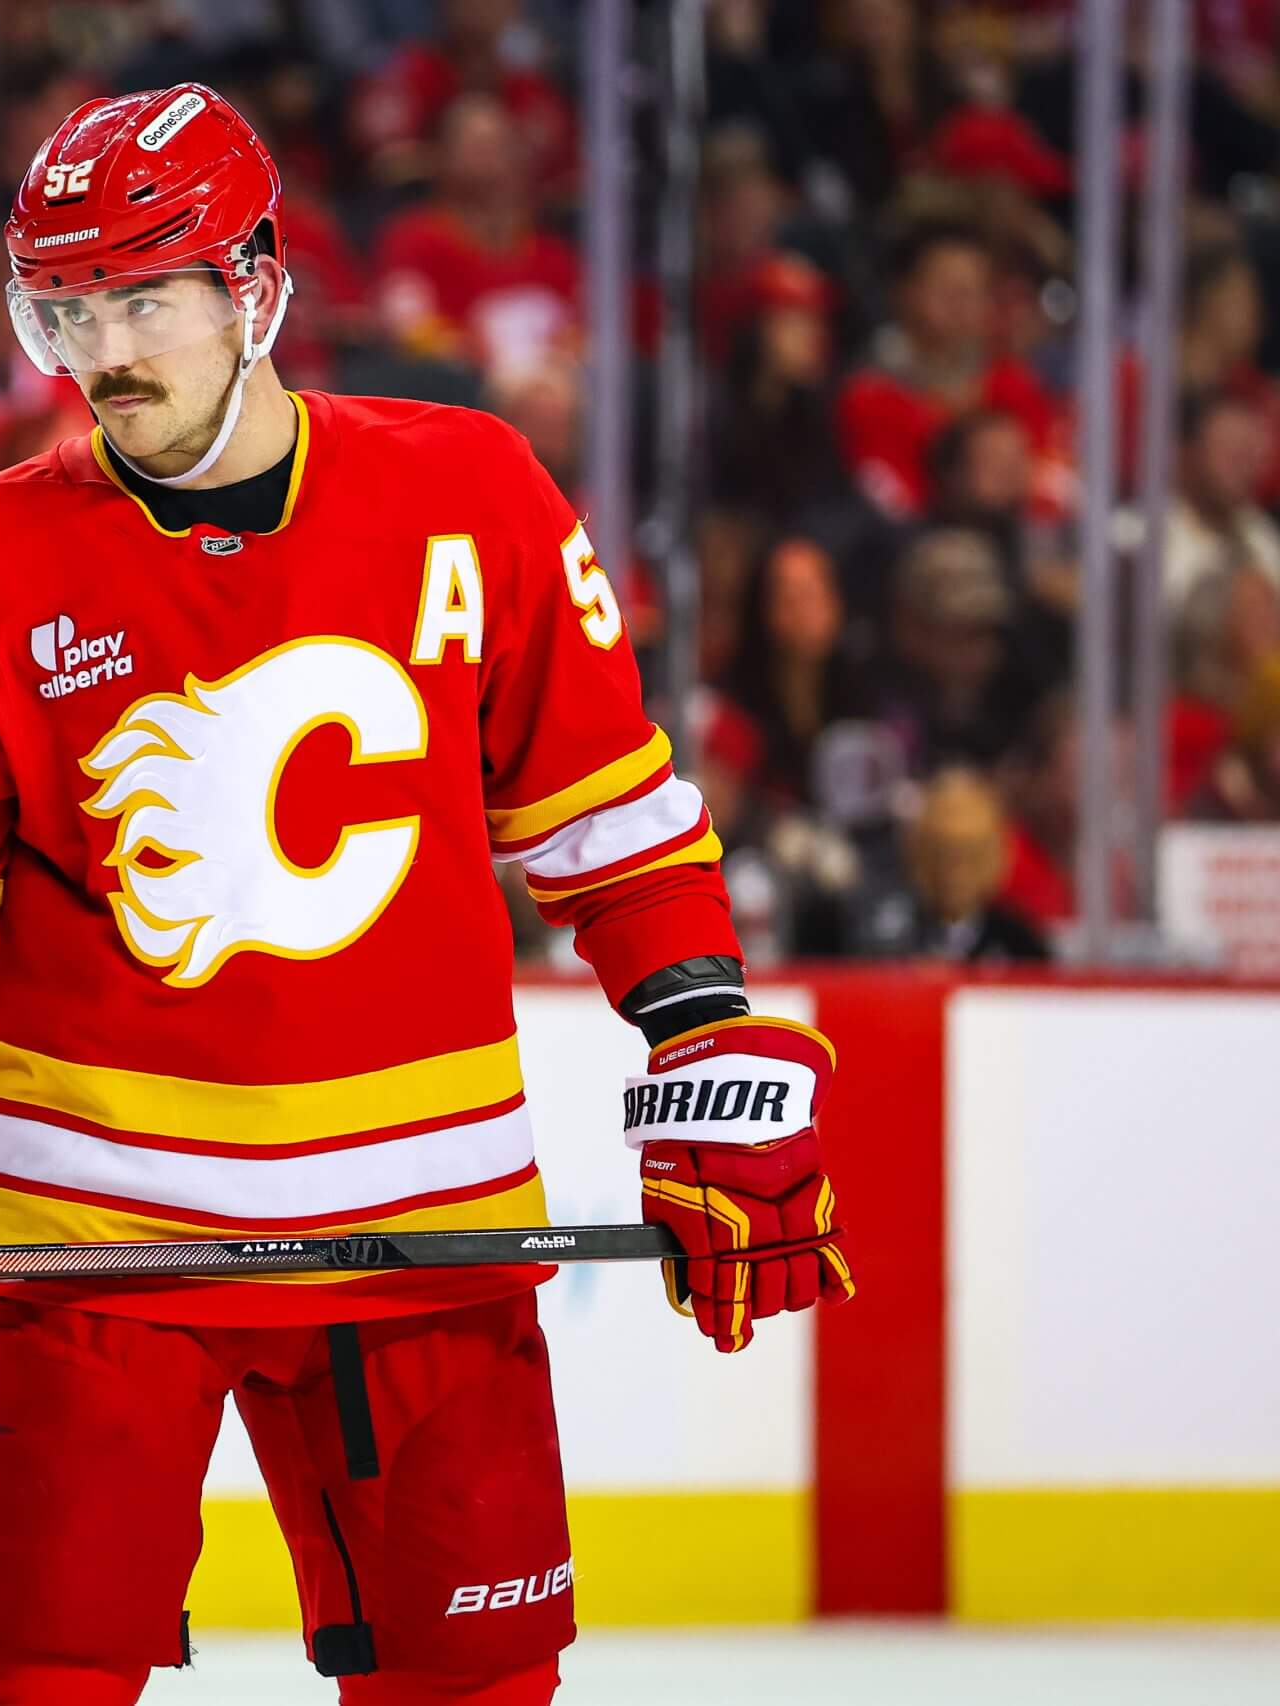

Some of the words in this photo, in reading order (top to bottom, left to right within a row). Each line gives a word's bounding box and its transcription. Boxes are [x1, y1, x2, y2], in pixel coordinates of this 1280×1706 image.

[143, 97, 201, 146] GameSense
[43, 160, 97, 198] 52
[34, 227, 100, 249] WARRIOR
[409, 533, 485, 665] A
[63, 630, 125, 673] play
[39, 654, 133, 699] alberta
[659, 1037, 715, 1066] WEEGAR
[645, 1159, 677, 1171] COVERT
[241, 1242, 304, 1253] ALPHA
[520, 1235, 576, 1249] ALLOY
